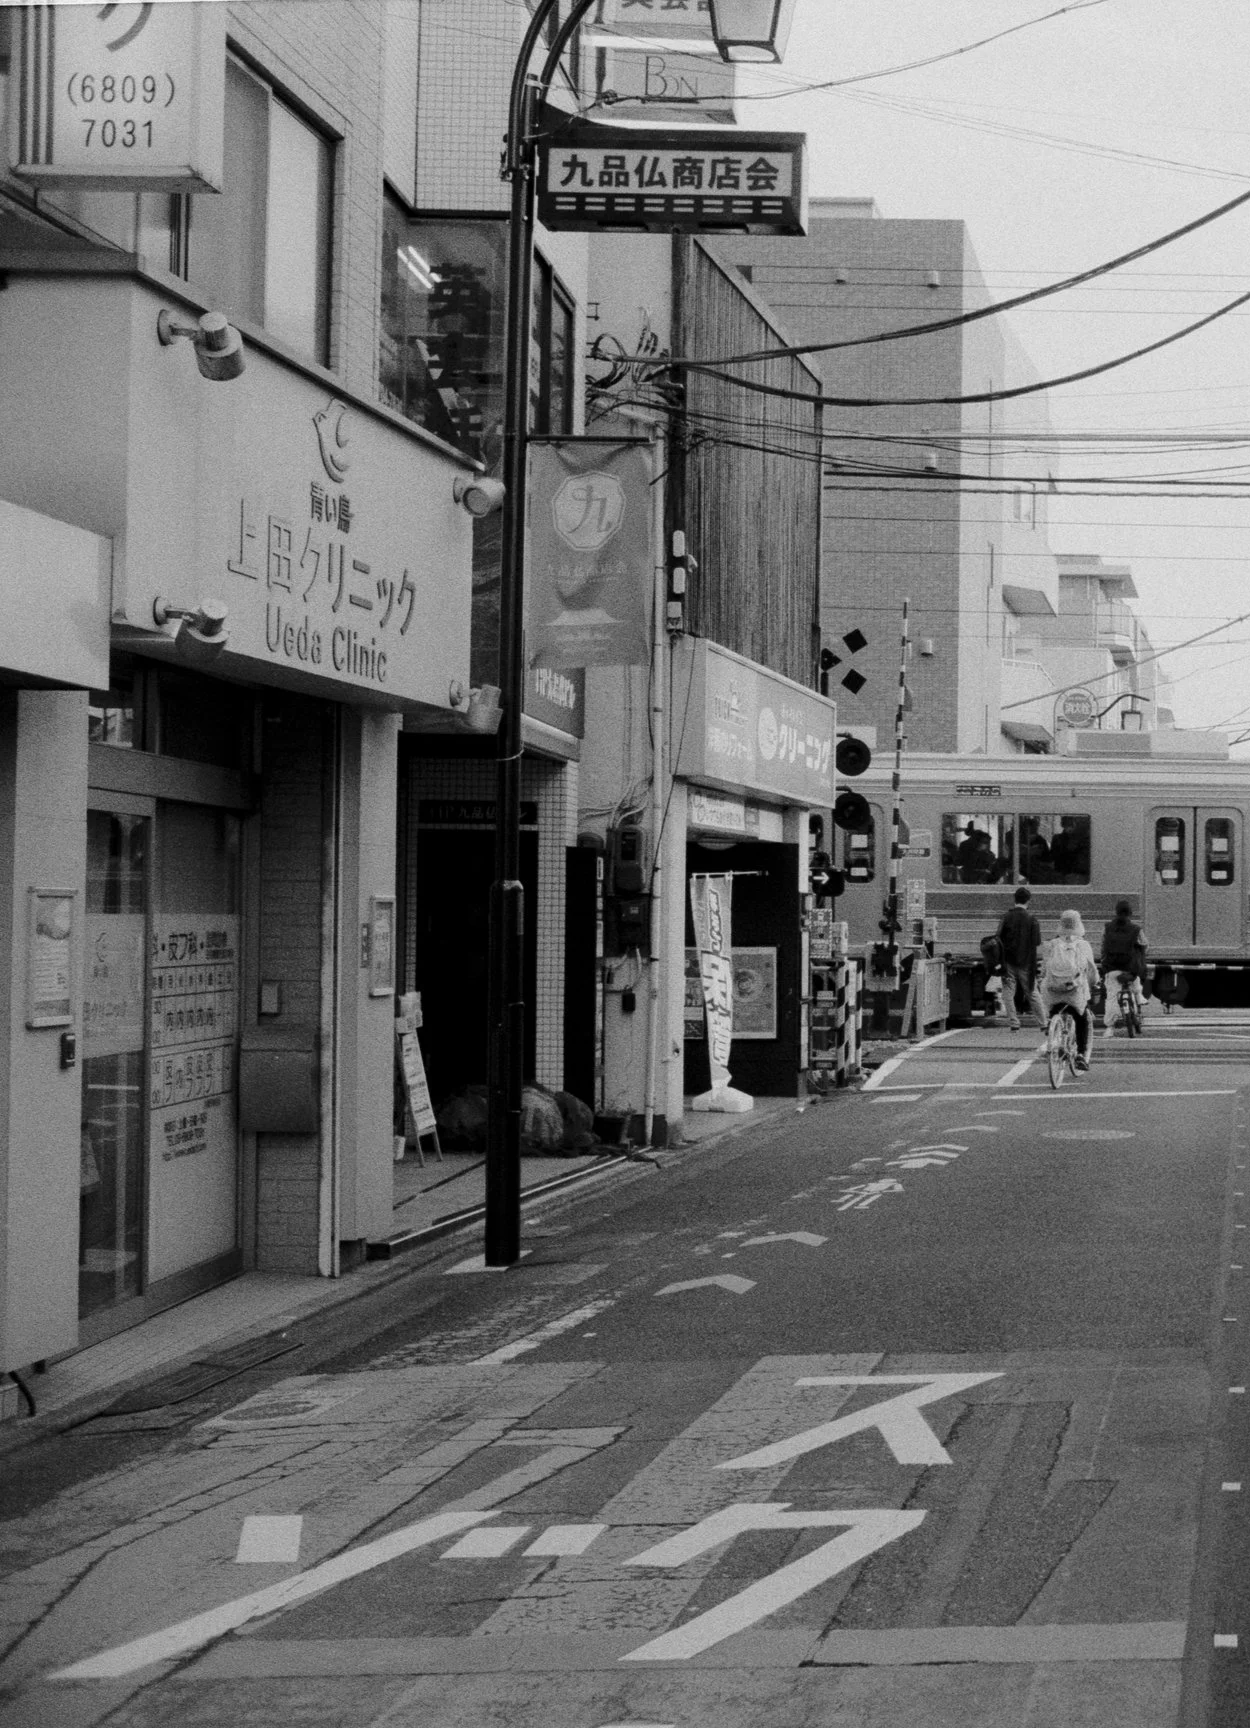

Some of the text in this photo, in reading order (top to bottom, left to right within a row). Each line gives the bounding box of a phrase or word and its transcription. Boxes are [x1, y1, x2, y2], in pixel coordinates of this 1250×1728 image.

[67, 72, 176, 107] (6809)
[81, 119, 154, 149] 7031
[560, 154, 780, 192] 九品仏商店会
[227, 498, 417, 636] 上田クリニック
[266, 602, 388, 683] Ueda Clinic
